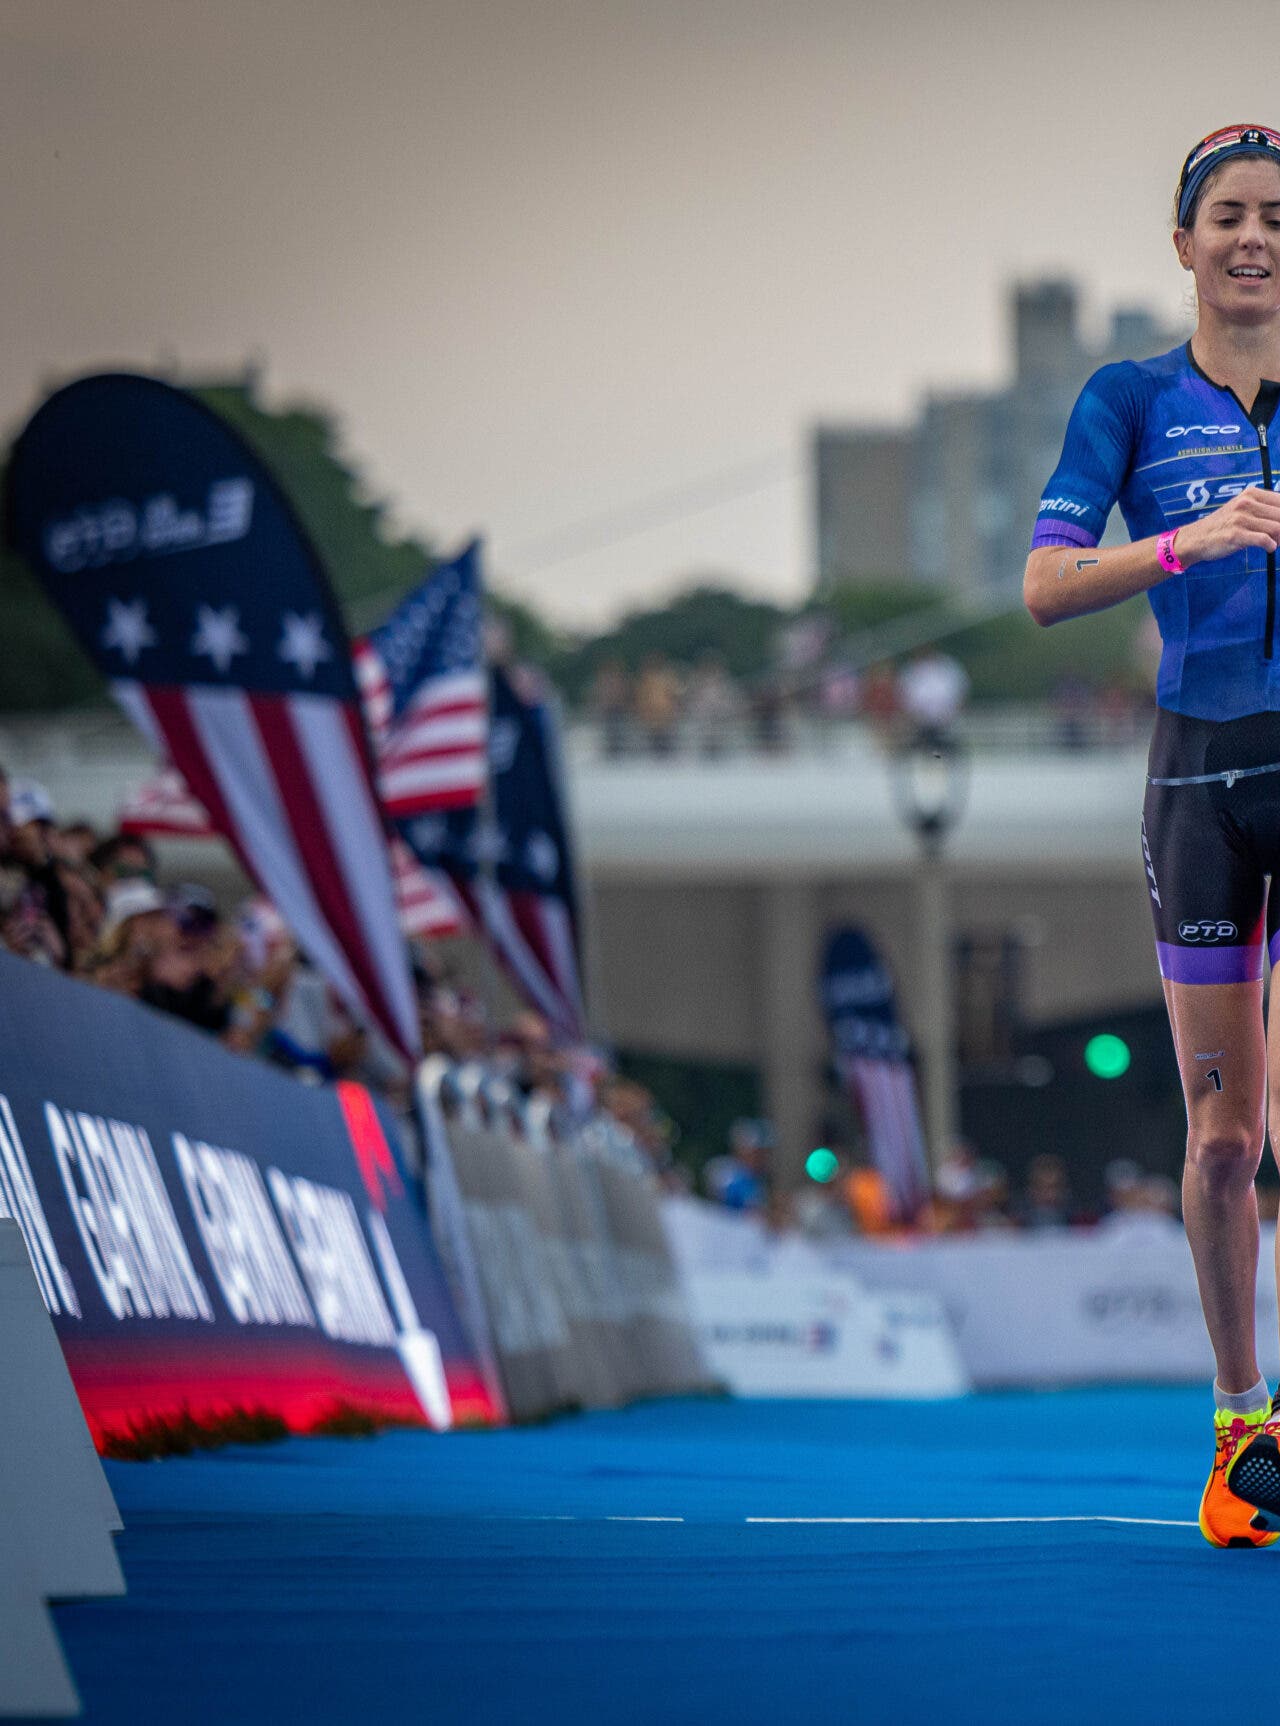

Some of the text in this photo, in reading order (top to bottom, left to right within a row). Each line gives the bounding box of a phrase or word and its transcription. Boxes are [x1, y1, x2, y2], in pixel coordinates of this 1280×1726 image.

[1162, 539, 1175, 565] PRO
[1076, 558, 1100, 573] 1
[1205, 1066, 1224, 1093] 1
